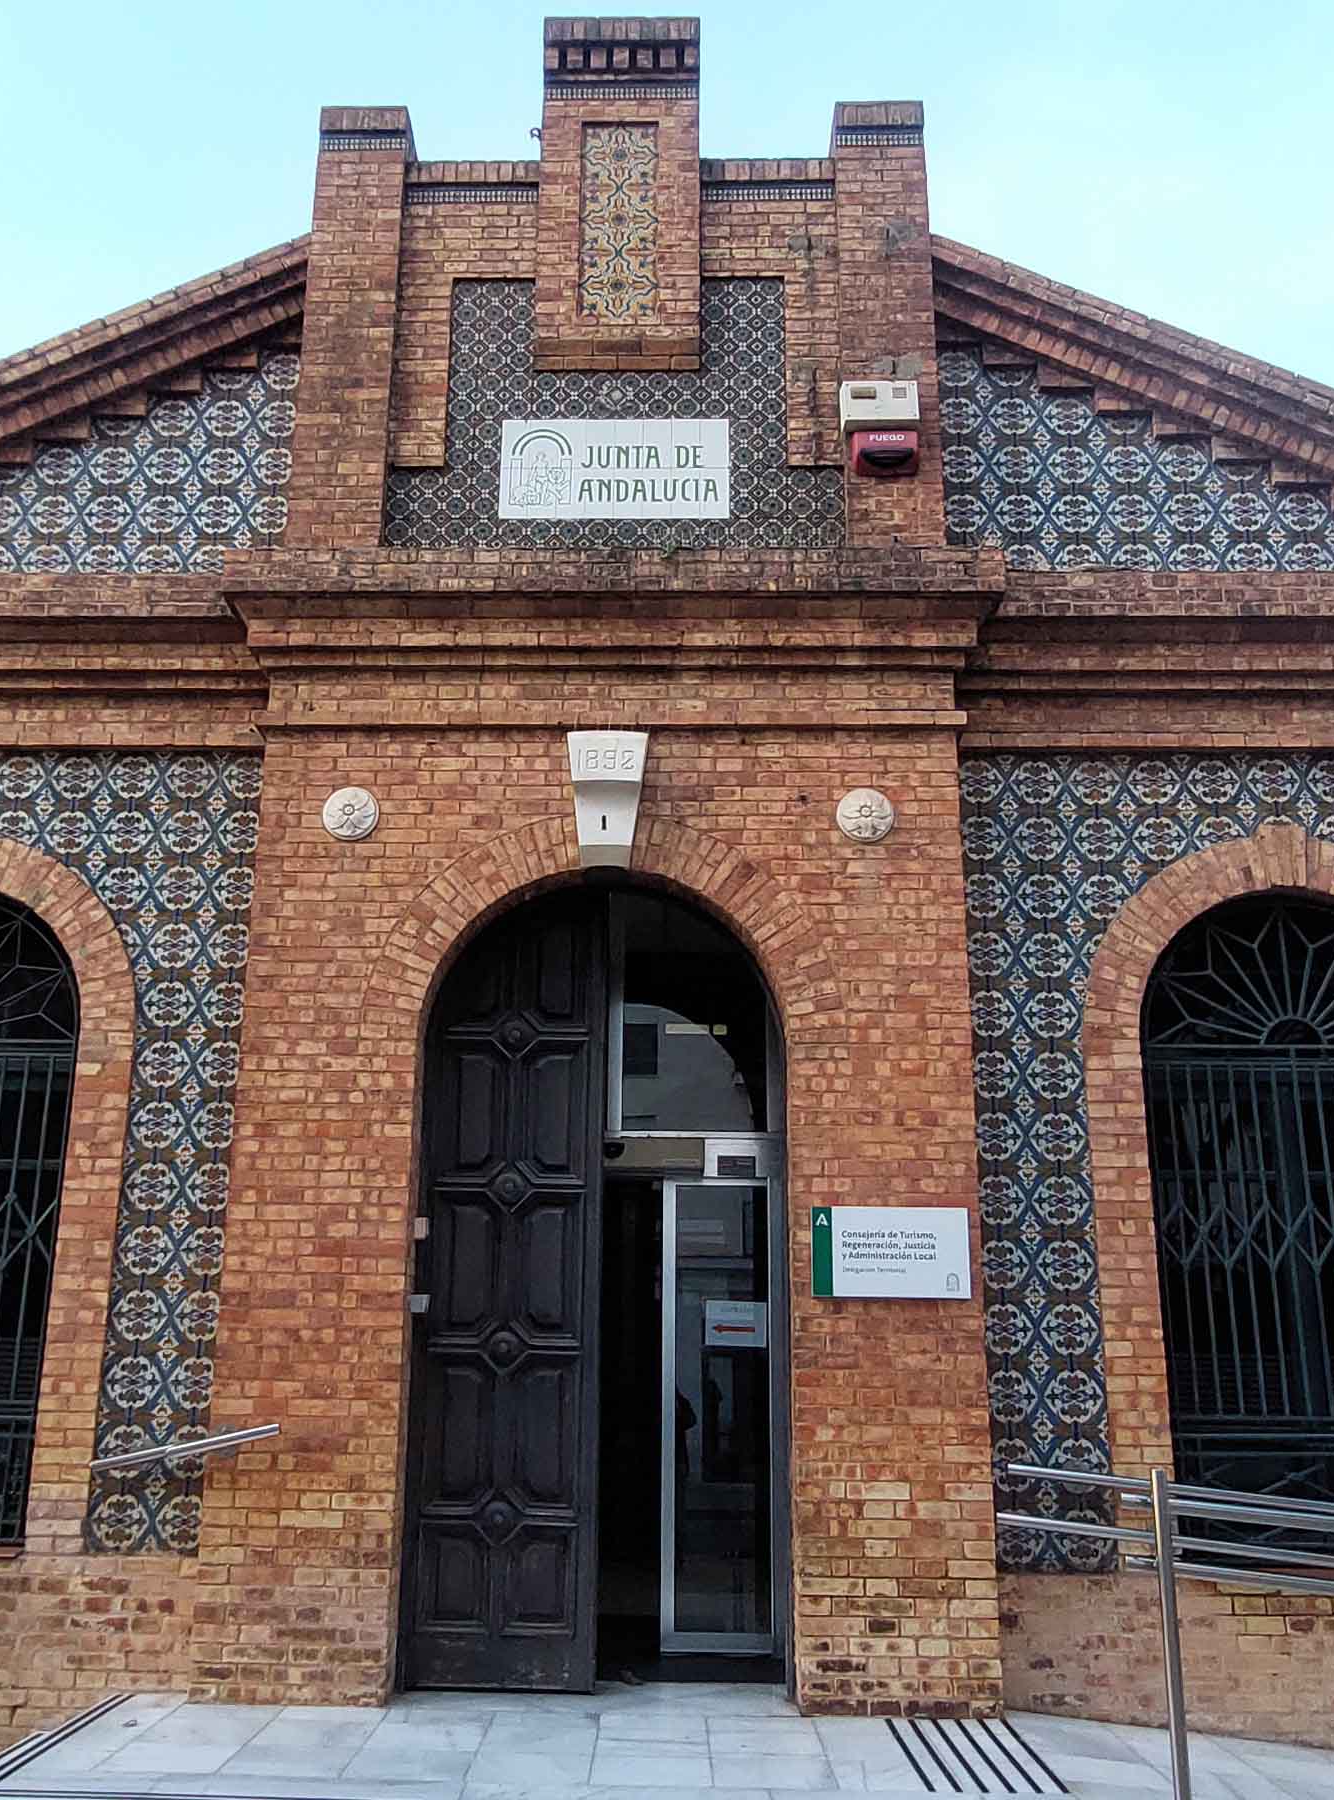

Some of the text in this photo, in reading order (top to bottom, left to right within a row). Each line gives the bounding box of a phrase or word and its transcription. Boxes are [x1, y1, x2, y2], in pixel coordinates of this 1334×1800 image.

[869, 433, 905, 442] FUEGO
[581, 445, 707, 469] JUNTA DE
[577, 748, 635, 770] 1892
[841, 1229, 937, 1240] Consejería de Turismo,
[841, 1240, 936, 1251] Regeneración, Justicia
[841, 1251, 937, 1261] y Administración Local
